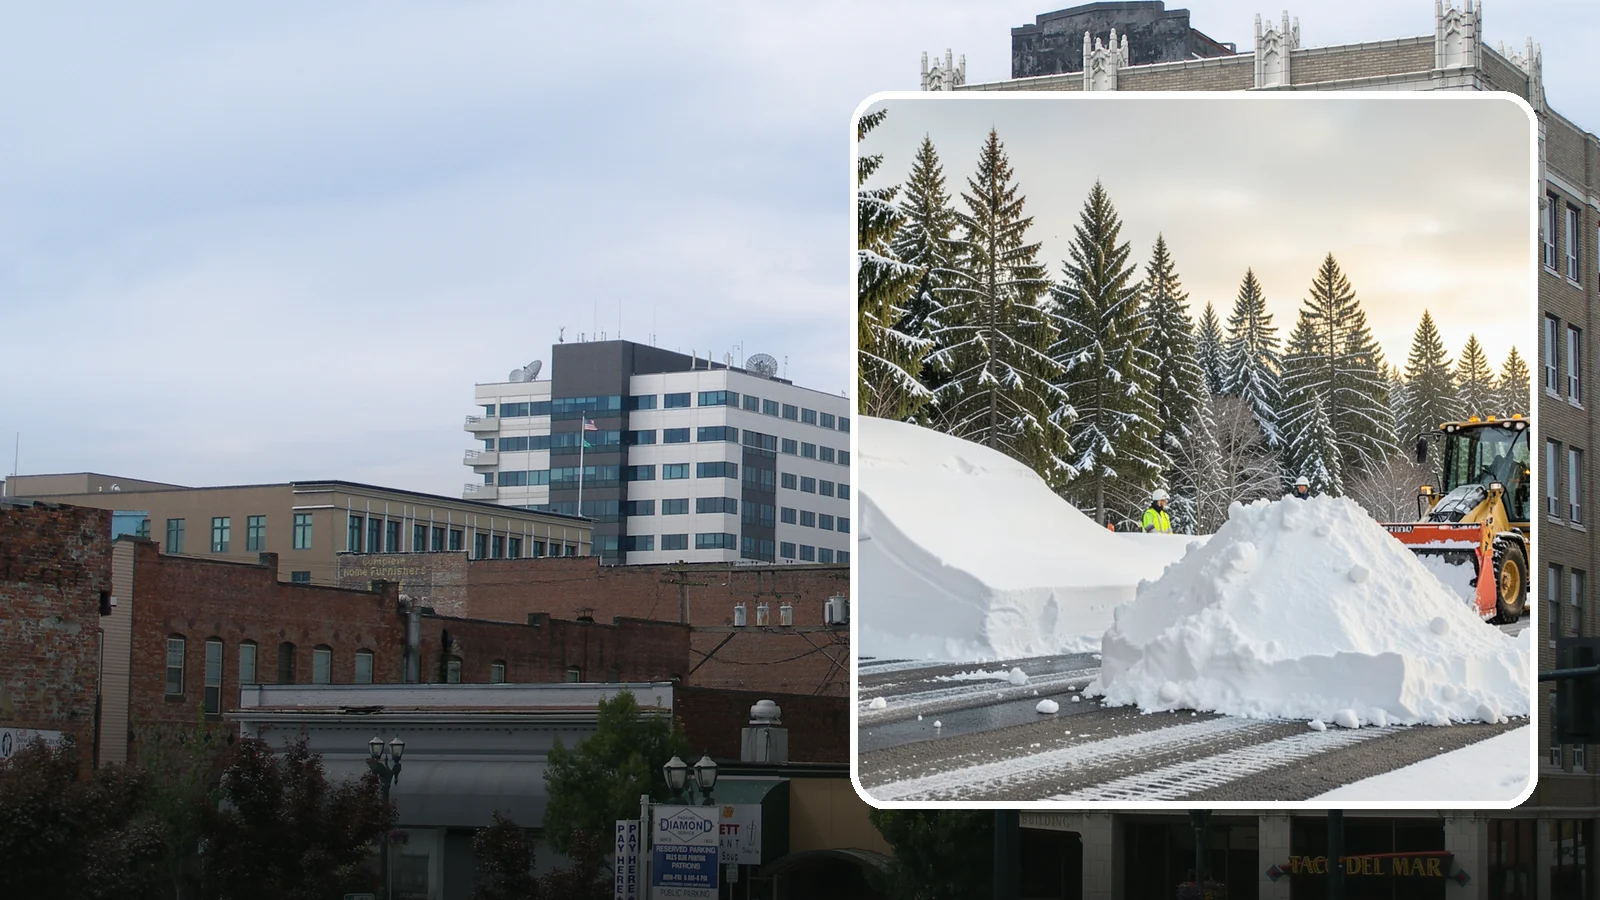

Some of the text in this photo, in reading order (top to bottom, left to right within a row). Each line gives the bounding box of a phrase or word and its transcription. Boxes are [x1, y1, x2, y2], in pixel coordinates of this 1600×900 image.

[660, 818, 713, 833] DIAMOND
[1022, 815, 1070, 828] BUILDING
[617, 825, 625, 852] PAY
[628, 825, 637, 852] PAY
[656, 845, 716, 854] RESERVED PARKING
[617, 856, 625, 893] HERE
[628, 856, 636, 893] HERE
[1290, 855, 1442, 877] TAC DEL MAR
[660, 888, 710, 898] PUBLIC PARKING
